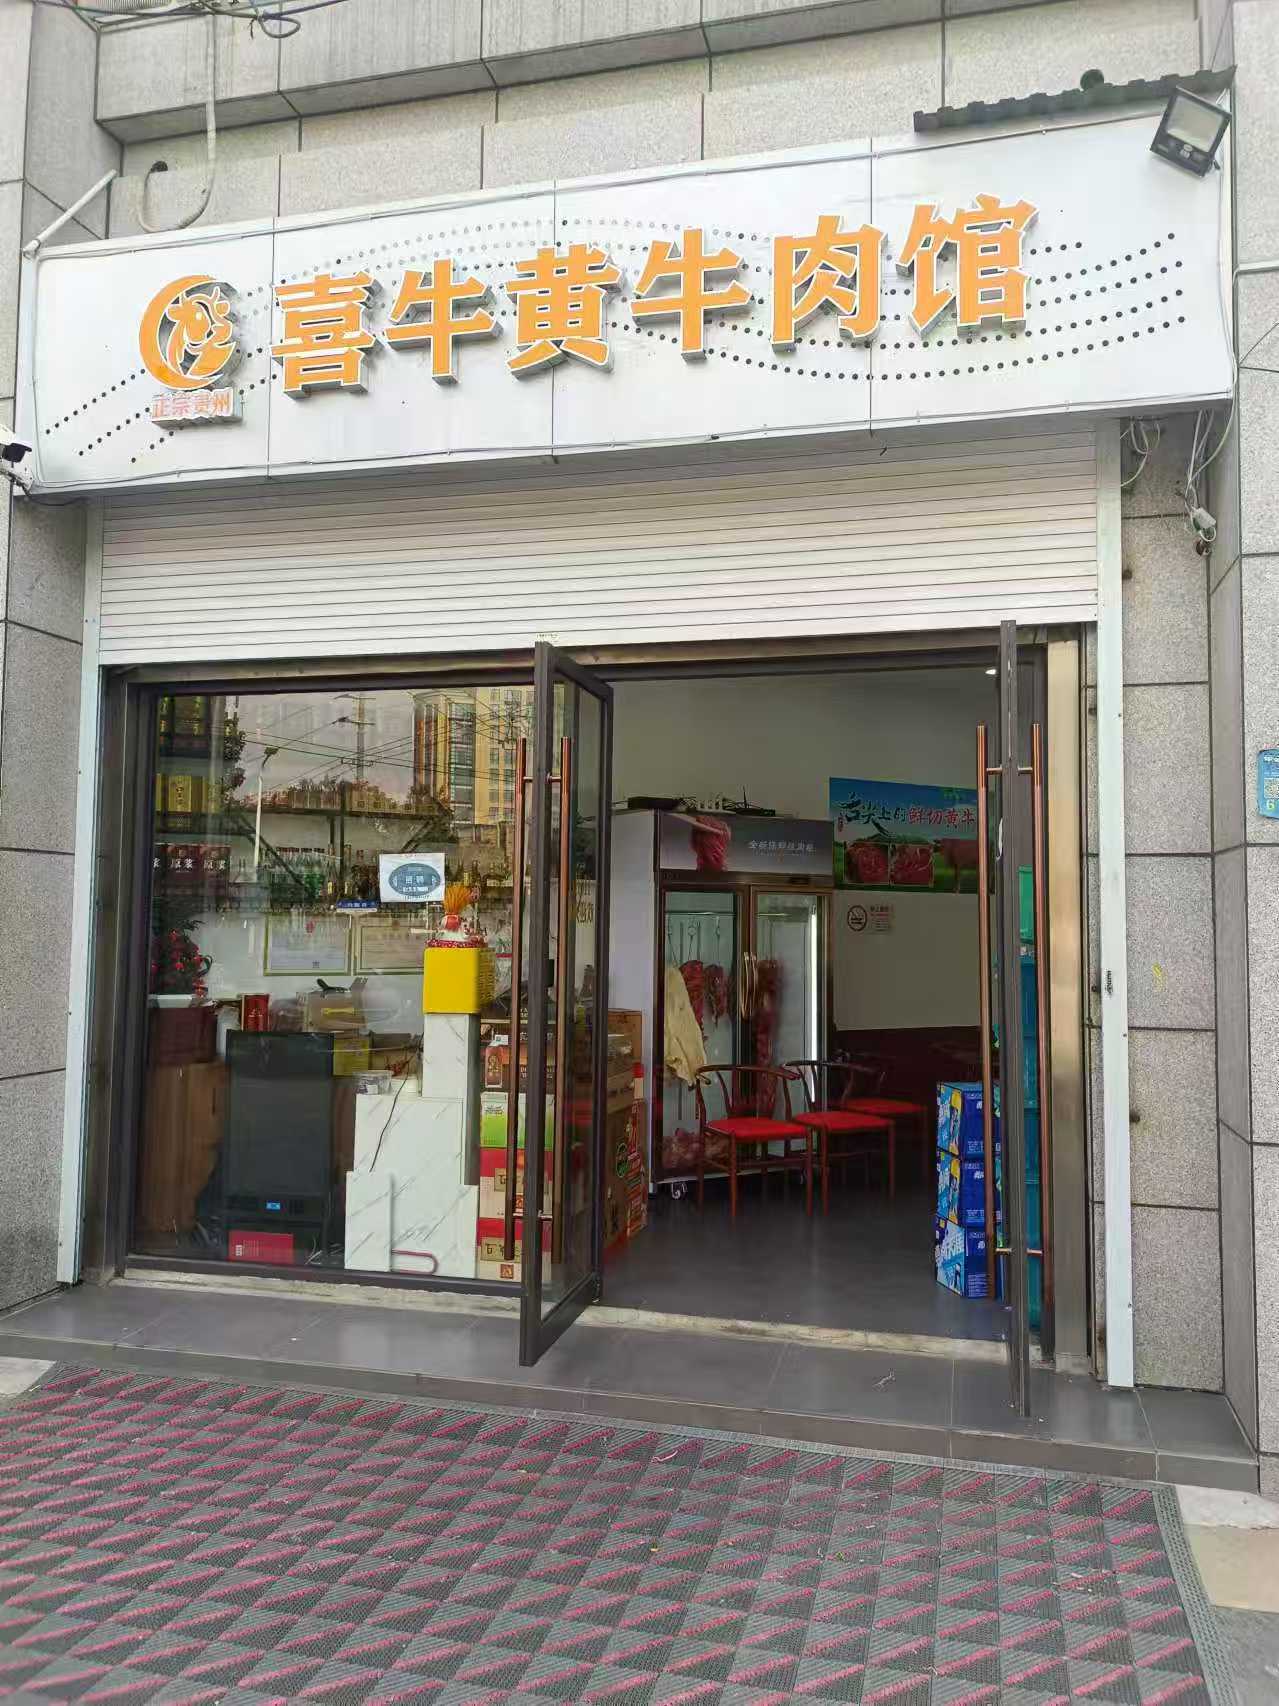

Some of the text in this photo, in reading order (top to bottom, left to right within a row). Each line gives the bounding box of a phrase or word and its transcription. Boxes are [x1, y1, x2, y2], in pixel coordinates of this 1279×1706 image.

[271, 194, 1038, 395] 喜牛黄牛肉馆
[152, 389, 232, 418] 正宗贵州
